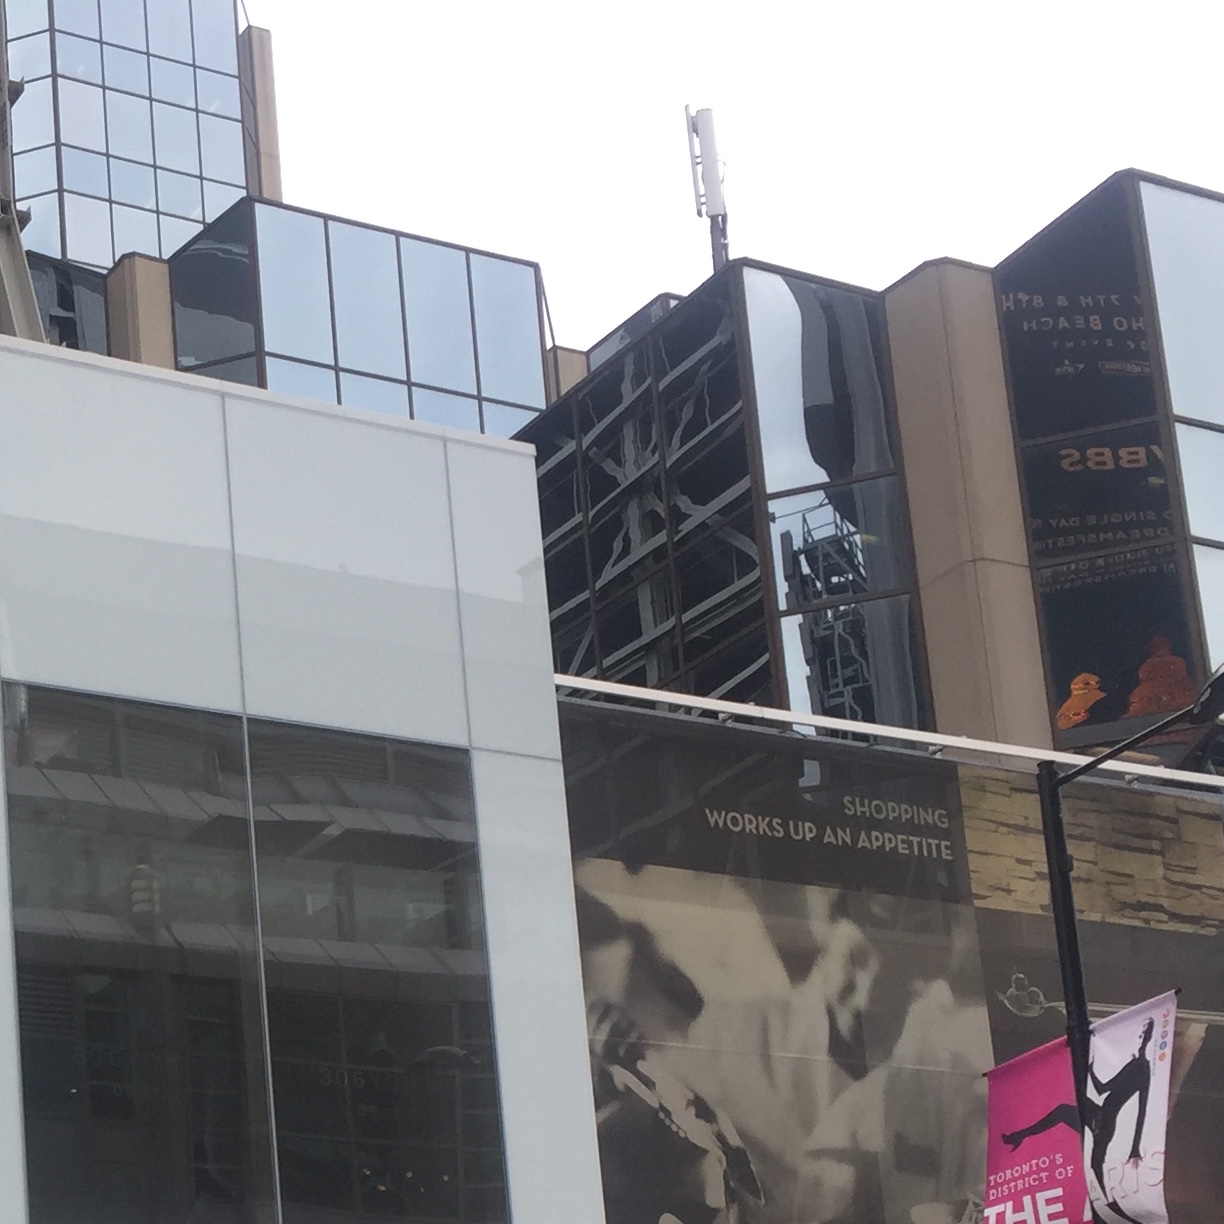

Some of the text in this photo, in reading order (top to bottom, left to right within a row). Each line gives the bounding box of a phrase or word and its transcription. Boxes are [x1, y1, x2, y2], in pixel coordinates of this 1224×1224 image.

[843, 796, 950, 829] SHOPPING
[704, 808, 953, 860] WORKS UP AN APPETITE
[988, 1153, 1064, 1187] TORONTO'S
[988, 1165, 1075, 1200] DISTRICT OF
